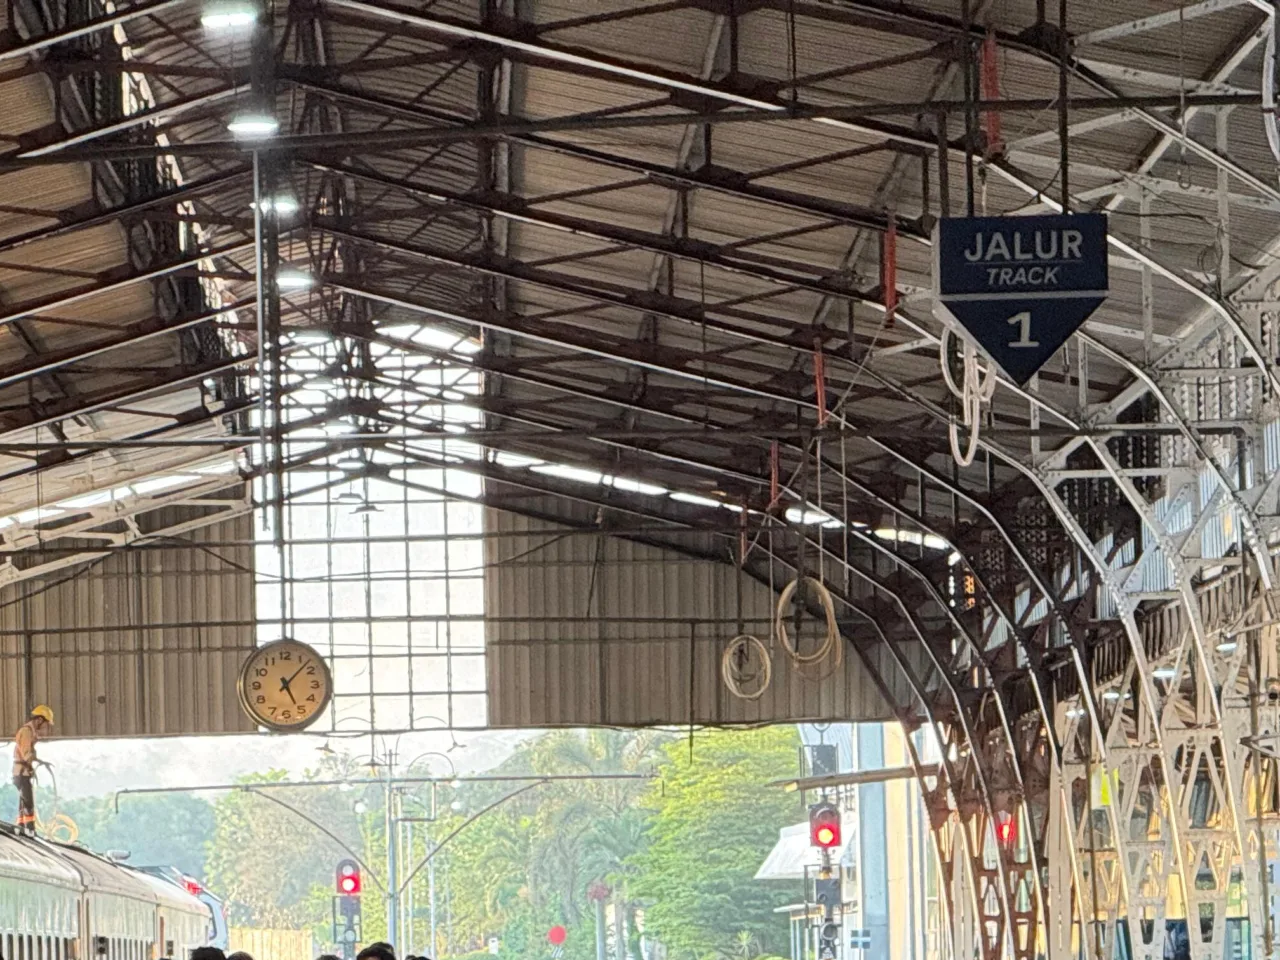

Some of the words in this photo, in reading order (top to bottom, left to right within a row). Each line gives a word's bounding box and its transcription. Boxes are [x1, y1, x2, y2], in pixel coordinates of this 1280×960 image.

[964, 230, 1083, 262] JALUR
[986, 266, 1061, 286] TRACK
[1007, 311, 1040, 348] 1
[280, 652, 291, 660] 12
[265, 657, 275, 666] 11
[256, 668, 268, 677] 10
[307, 666, 315, 675] 2
[252, 682, 261, 690] 9
[311, 681, 320, 689] 3
[257, 695, 265, 704] 8
[306, 694, 315, 702] 4
[268, 707, 277, 715] 7
[282, 710, 291, 718] 6
[297, 706, 306, 714] 5
